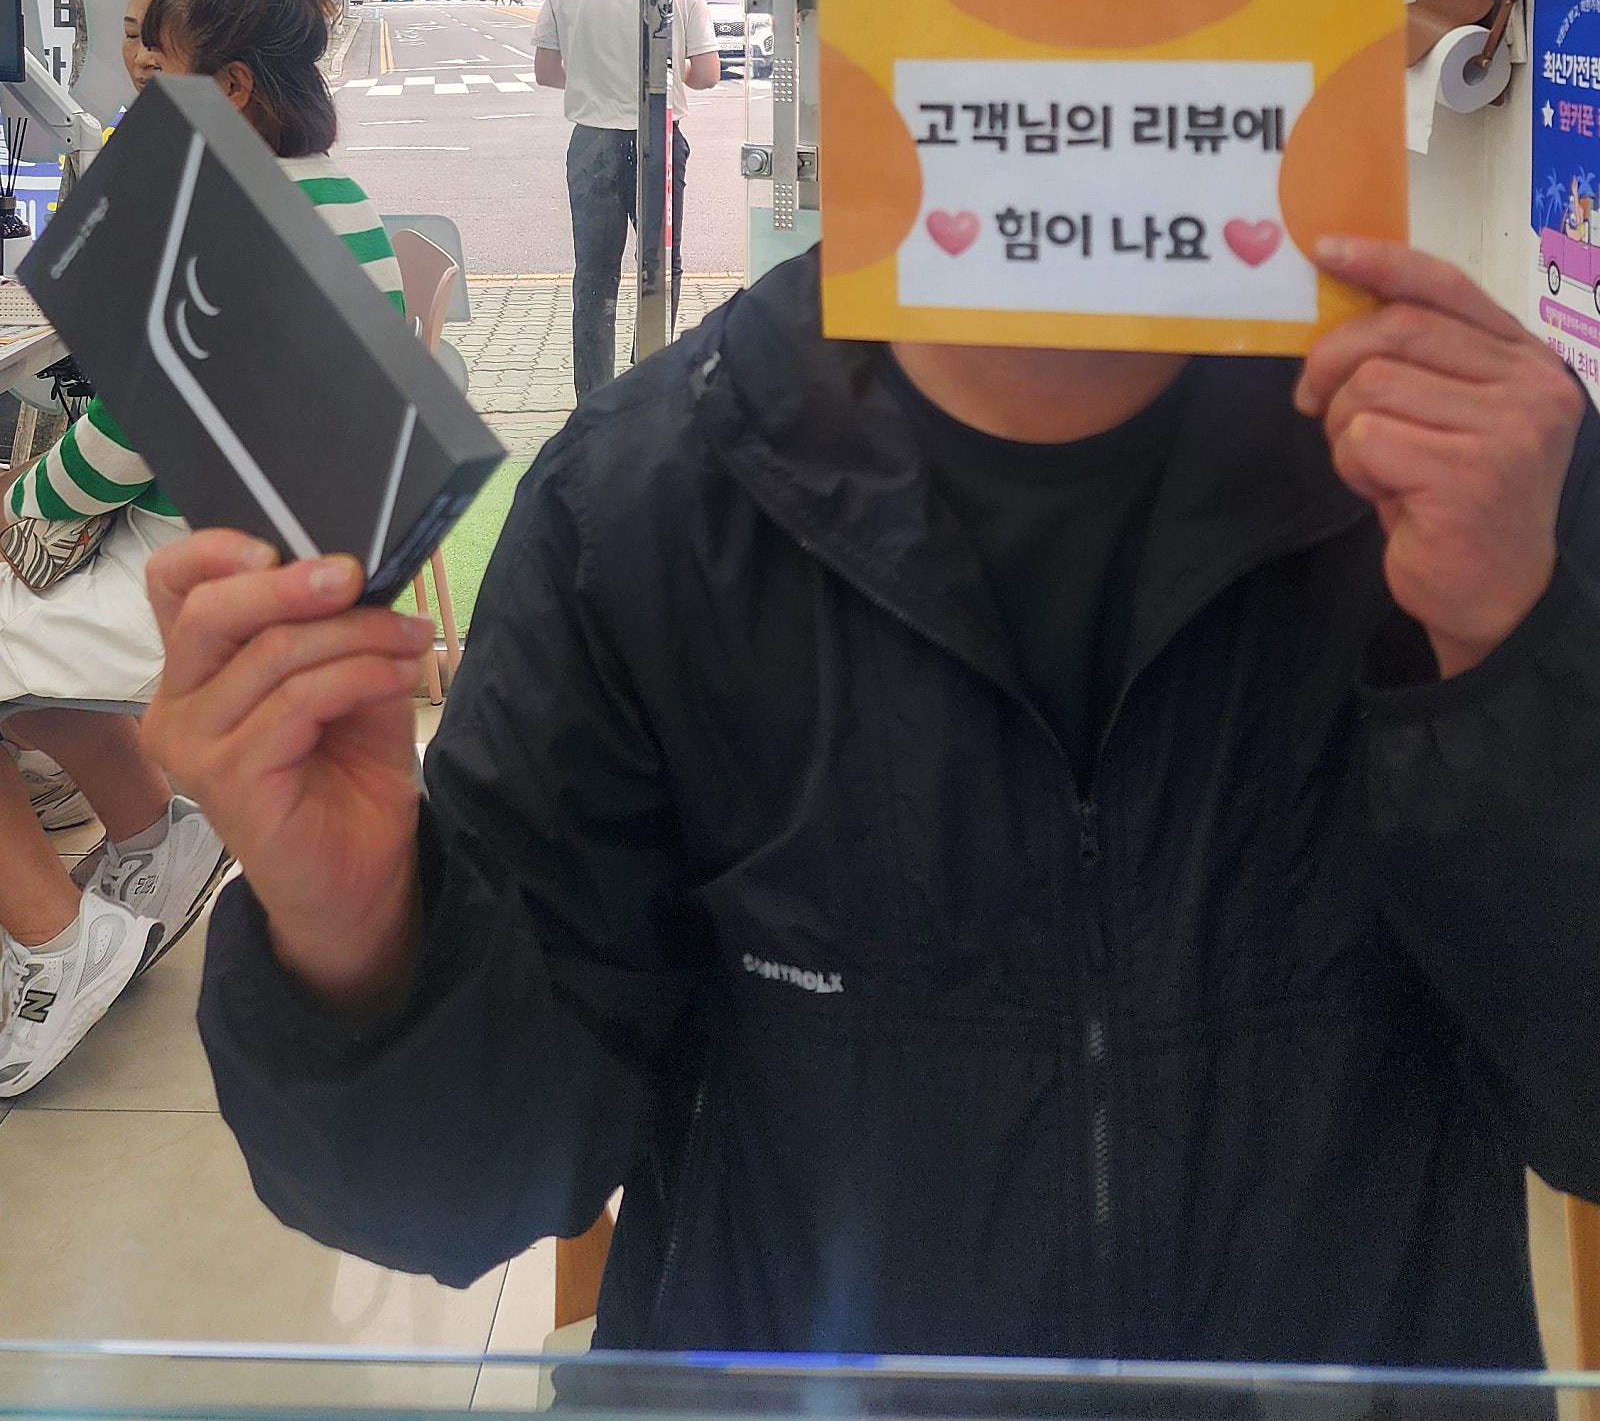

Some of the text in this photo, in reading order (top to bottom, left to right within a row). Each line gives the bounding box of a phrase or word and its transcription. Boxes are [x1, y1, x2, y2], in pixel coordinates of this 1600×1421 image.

[914, 103, 1286, 156] 고객님의 리뷰에
[1559, 100, 1594, 138] 옆커폰
[995, 204, 1211, 263] 힘이 나요
